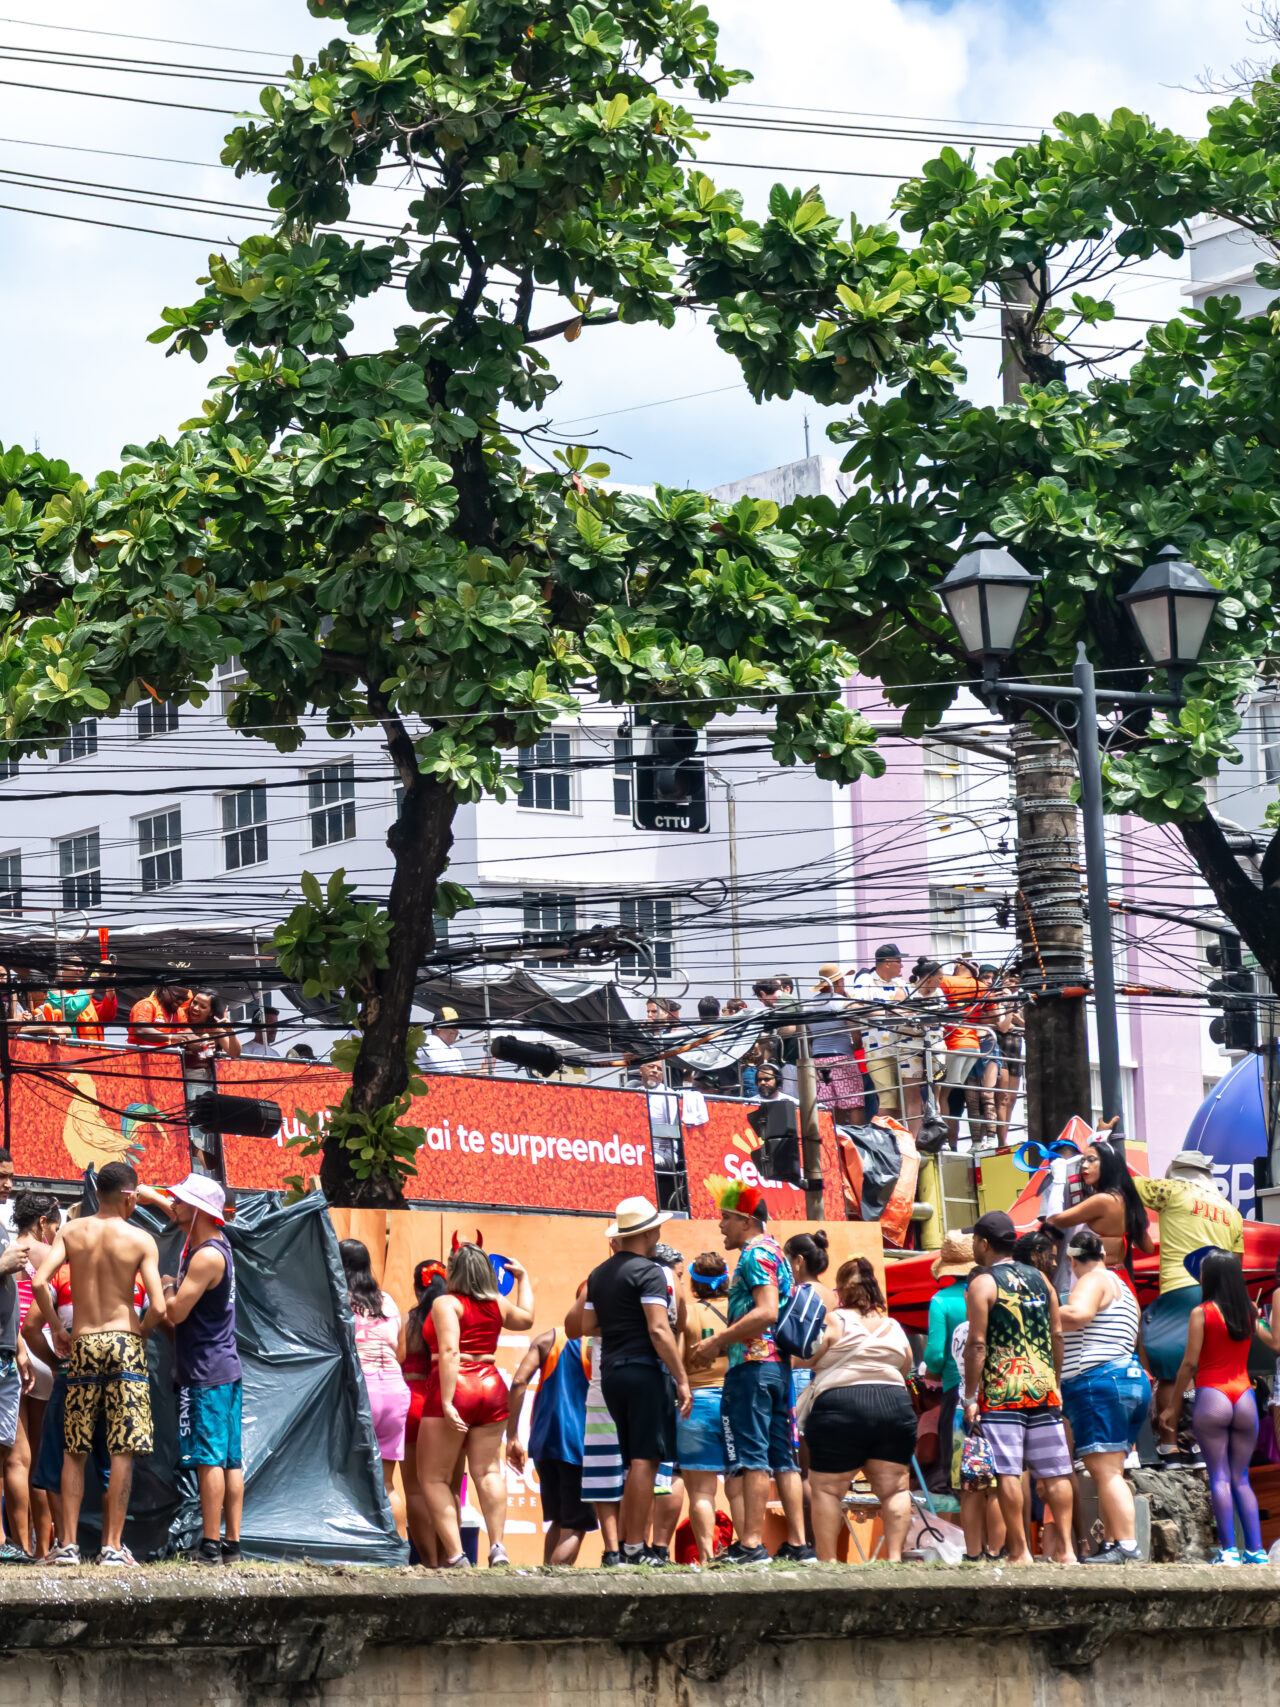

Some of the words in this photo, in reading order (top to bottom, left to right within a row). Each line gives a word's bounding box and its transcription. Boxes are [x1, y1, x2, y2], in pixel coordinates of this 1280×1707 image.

[654, 815, 690, 829] CTTU
[418, 1119, 452, 1150] ai
[457, 1124, 485, 1154] te
[490, 1131, 646, 1167] surpreender
[179, 1386, 192, 1437] SEAWA
